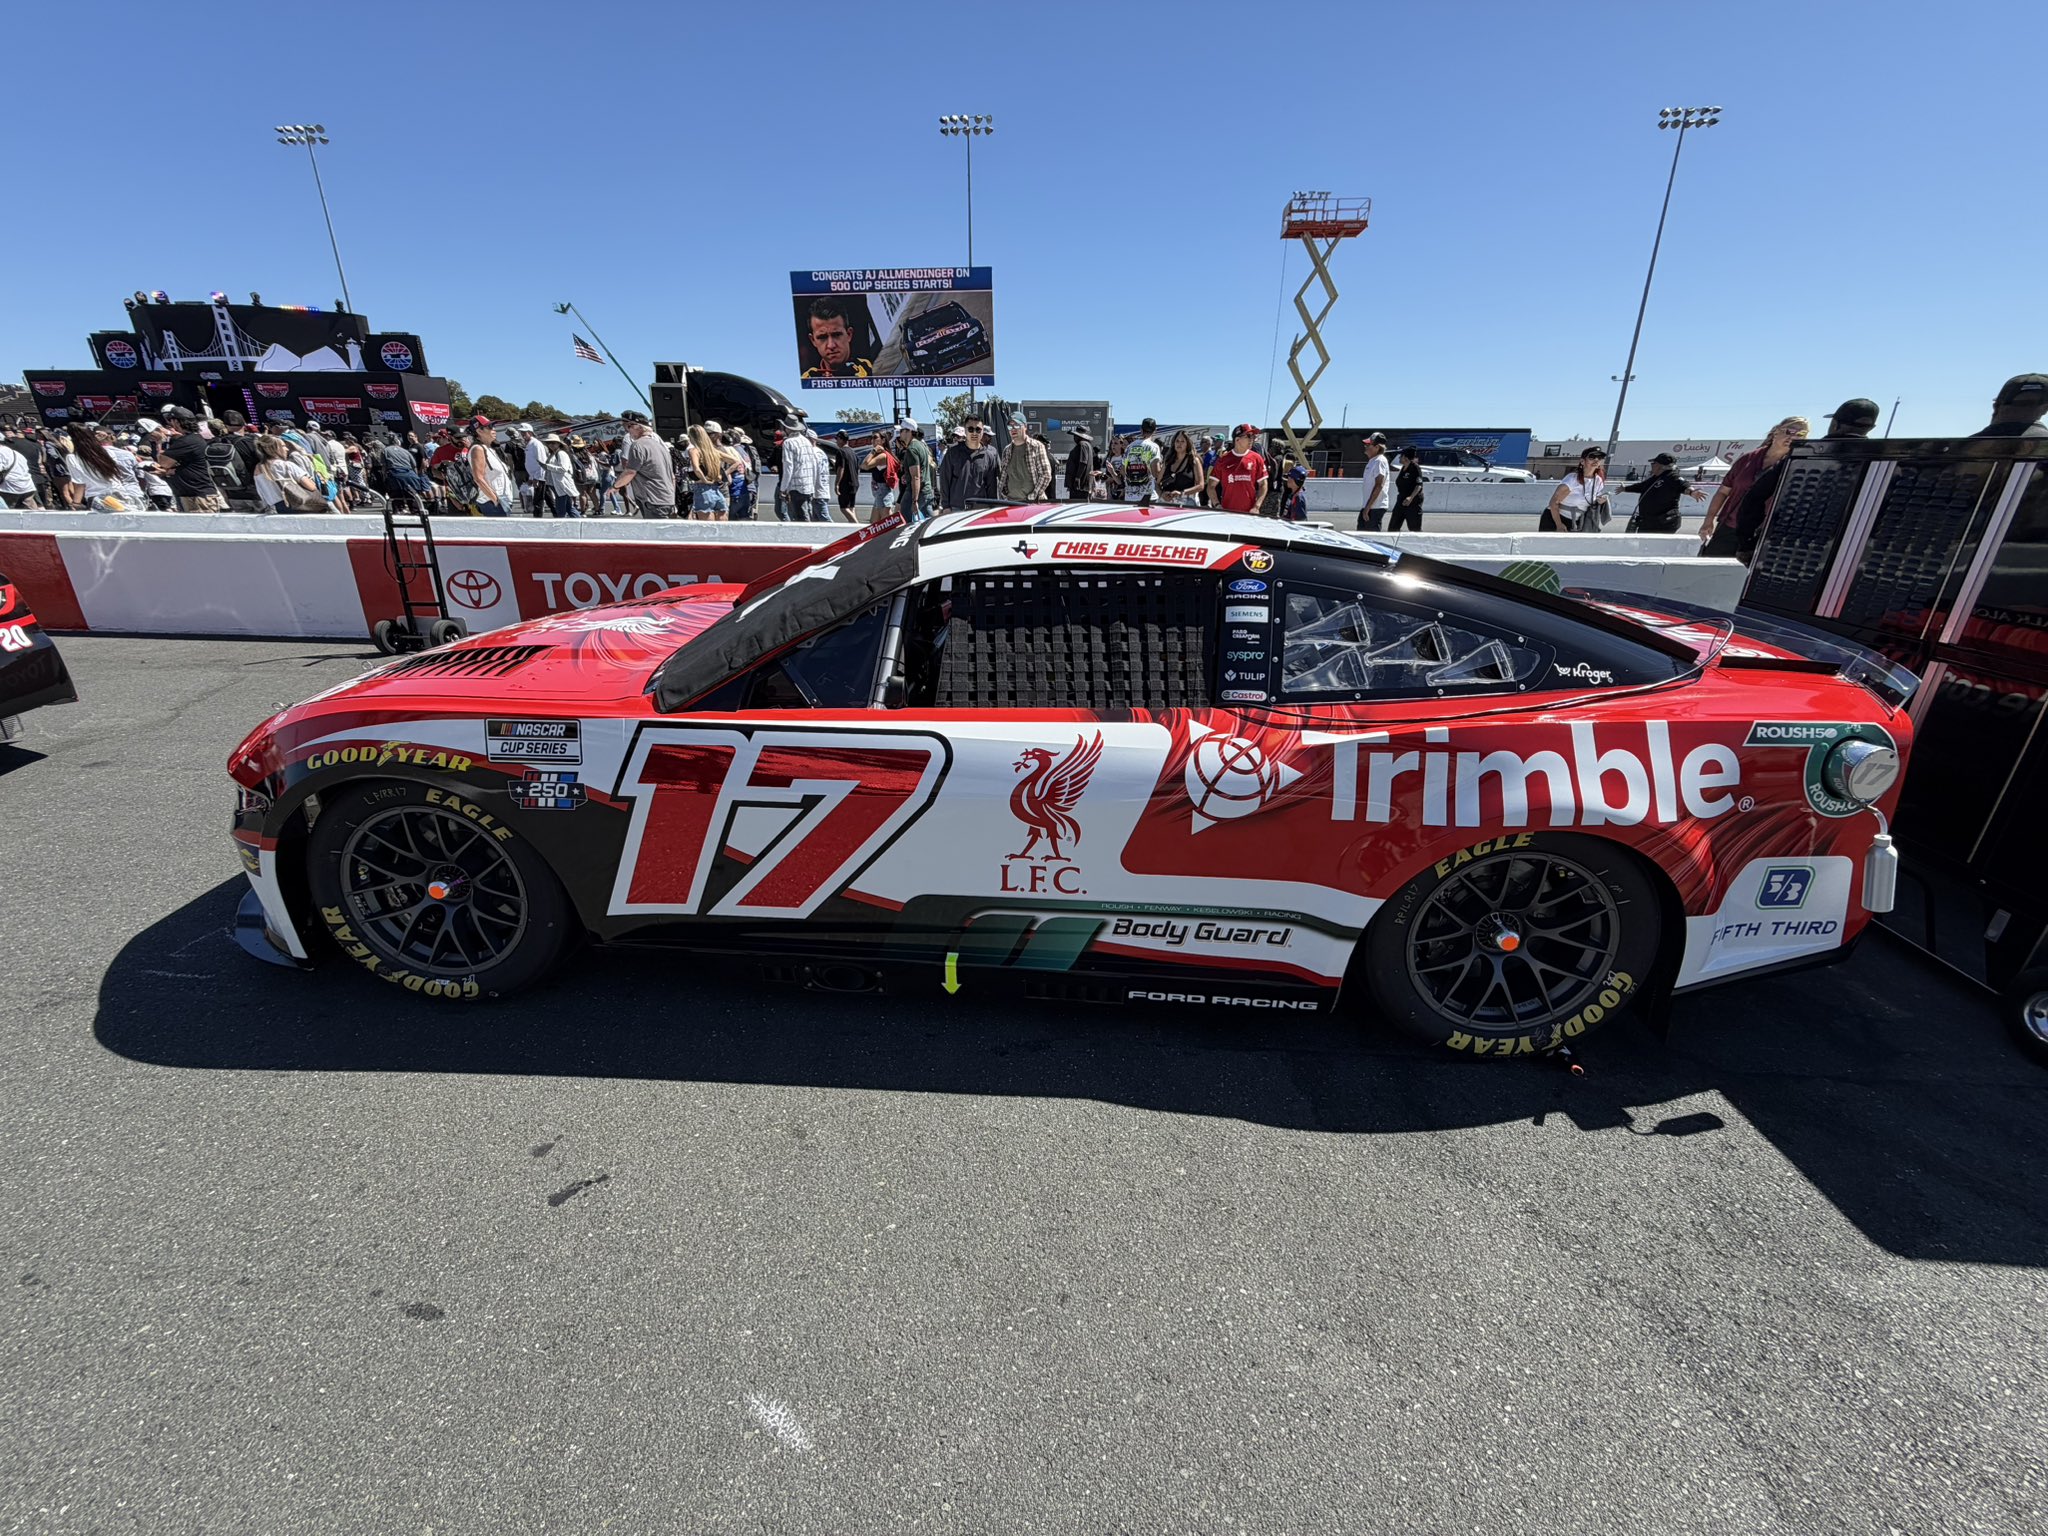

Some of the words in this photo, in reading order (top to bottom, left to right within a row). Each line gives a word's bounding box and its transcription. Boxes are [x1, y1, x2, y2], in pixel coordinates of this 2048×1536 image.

[812, 271, 863, 281] CONGRATS
[865, 270, 876, 280] AJ
[878, 268, 954, 279] ALLMENDINGER
[956, 268, 970, 278] ON
[830, 282, 850, 291] 500
[852, 281, 872, 290] CUP
[875, 280, 910, 290] SERIES
[912, 279, 952, 289] STARTS!
[811, 379, 839, 388] FIRST
[841, 379, 871, 388] START:
[873, 378, 906, 387] MARCH
[908, 378, 931, 387] 2007
[933, 378, 943, 386] AT
[946, 377, 984, 386] BRISTOL
[322, 412, 347, 425] 350
[1684, 443, 1711, 453] Lucky
[1726, 441, 1745, 450] The
[867, 516, 900, 535] Trimble
[1051, 541, 1108, 557] CHRIS
[1114, 543, 1208, 562] BUESCHER
[1251, 560, 1267, 569] 16
[532, 571, 724, 610] TOYO
[1235, 581, 1260, 590] Ford
[0, 624, 33, 652] 20
[1226, 650, 1264, 662] syspro
[1239, 672, 1266, 681] TULIP
[1572, 662, 1611, 685] Kroger
[1231, 692, 1264, 700] Castrol
[515, 723, 566, 737] NASCAR
[500, 741, 524, 753] CUP
[526, 742, 568, 754] SERIES
[1302, 719, 1742, 828] Trimble
[1853, 762, 1897, 786] 17
[528, 782, 569, 798] 250
[425, 787, 515, 843] EAGLE
[607, 724, 950, 920] 17
[1434, 831, 1535, 880] EAGLE
[1000, 864, 1088, 895] L.F.C.
[1193, 906, 1253, 916] KESELOWSKI
[1264, 911, 1302, 920] RACING
[1112, 918, 1192, 946] Body
[1194, 923, 1294, 947] Guard
[1711, 922, 1762, 946] FIFTH
[1772, 920, 1839, 936] THIRD
[1127, 990, 1206, 1003] FORD
[1211, 996, 1319, 1011] RACING
